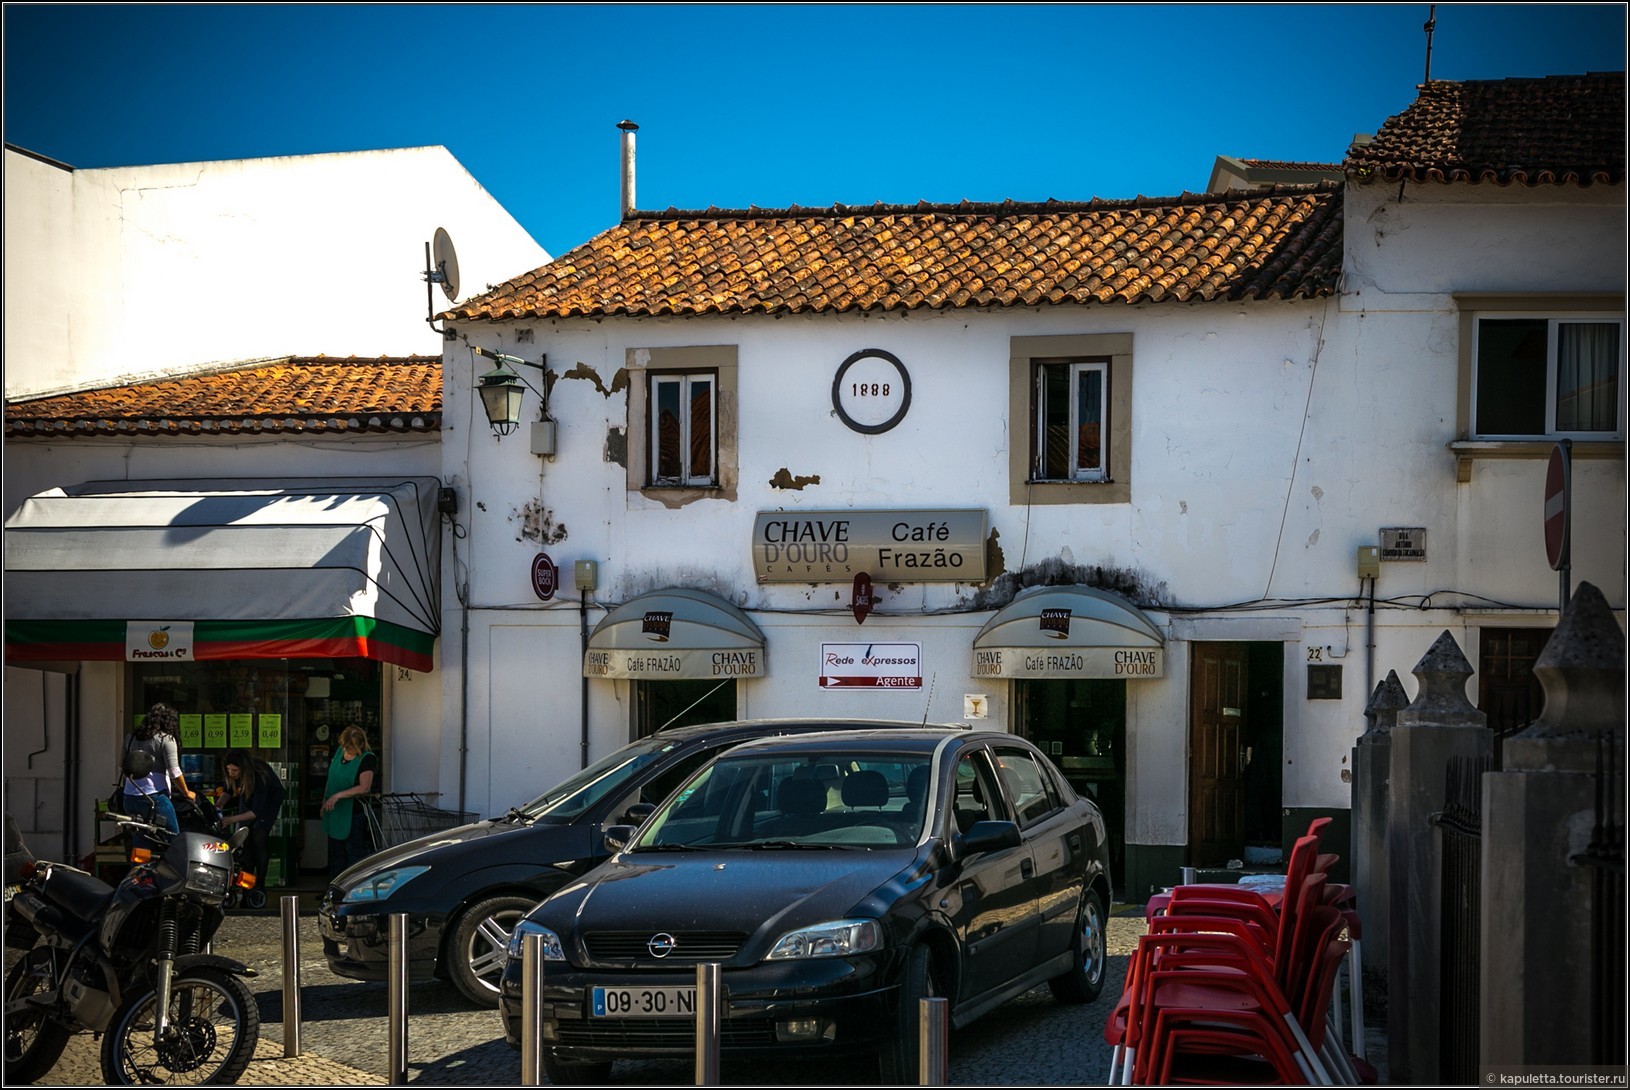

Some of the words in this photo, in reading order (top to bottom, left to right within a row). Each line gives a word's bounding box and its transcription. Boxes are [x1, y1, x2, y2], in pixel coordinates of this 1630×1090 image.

[853, 383, 890, 396] 1888
[764, 521, 850, 542] CHAVE
[891, 522, 950, 541] Café
[763, 543, 848, 563] D'OURO
[878, 548, 963, 567] Frazão
[537, 569, 552, 577] SUPER
[767, 563, 851, 573] CAFÉS
[538, 577, 552, 586] BOCK
[588, 653, 609, 664] CHAVE
[712, 652, 756, 664] CHAVE
[976, 652, 1002, 663] CHAVE
[1114, 651, 1156, 663] CHAVE
[1309, 648, 1321, 659] 22
[627, 658, 644, 671] Café
[646, 656, 681, 672] FRAZÃO
[826, 653, 854, 667] Rede
[1025, 656, 1044, 670] Café
[1047, 653, 1084, 670] FRAZÃO
[400, 669, 409, 678] 24
[712, 664, 756, 675] D'OURO
[976, 663, 1002, 675] D'OURO
[1114, 663, 1156, 675] D'OURO
[876, 677, 915, 687] Agente
[183, 730, 199, 738] 1,69
[207, 730, 224, 739] 0,99
[233, 730, 250, 738] 2,59
[262, 730, 279, 738] 0,40
